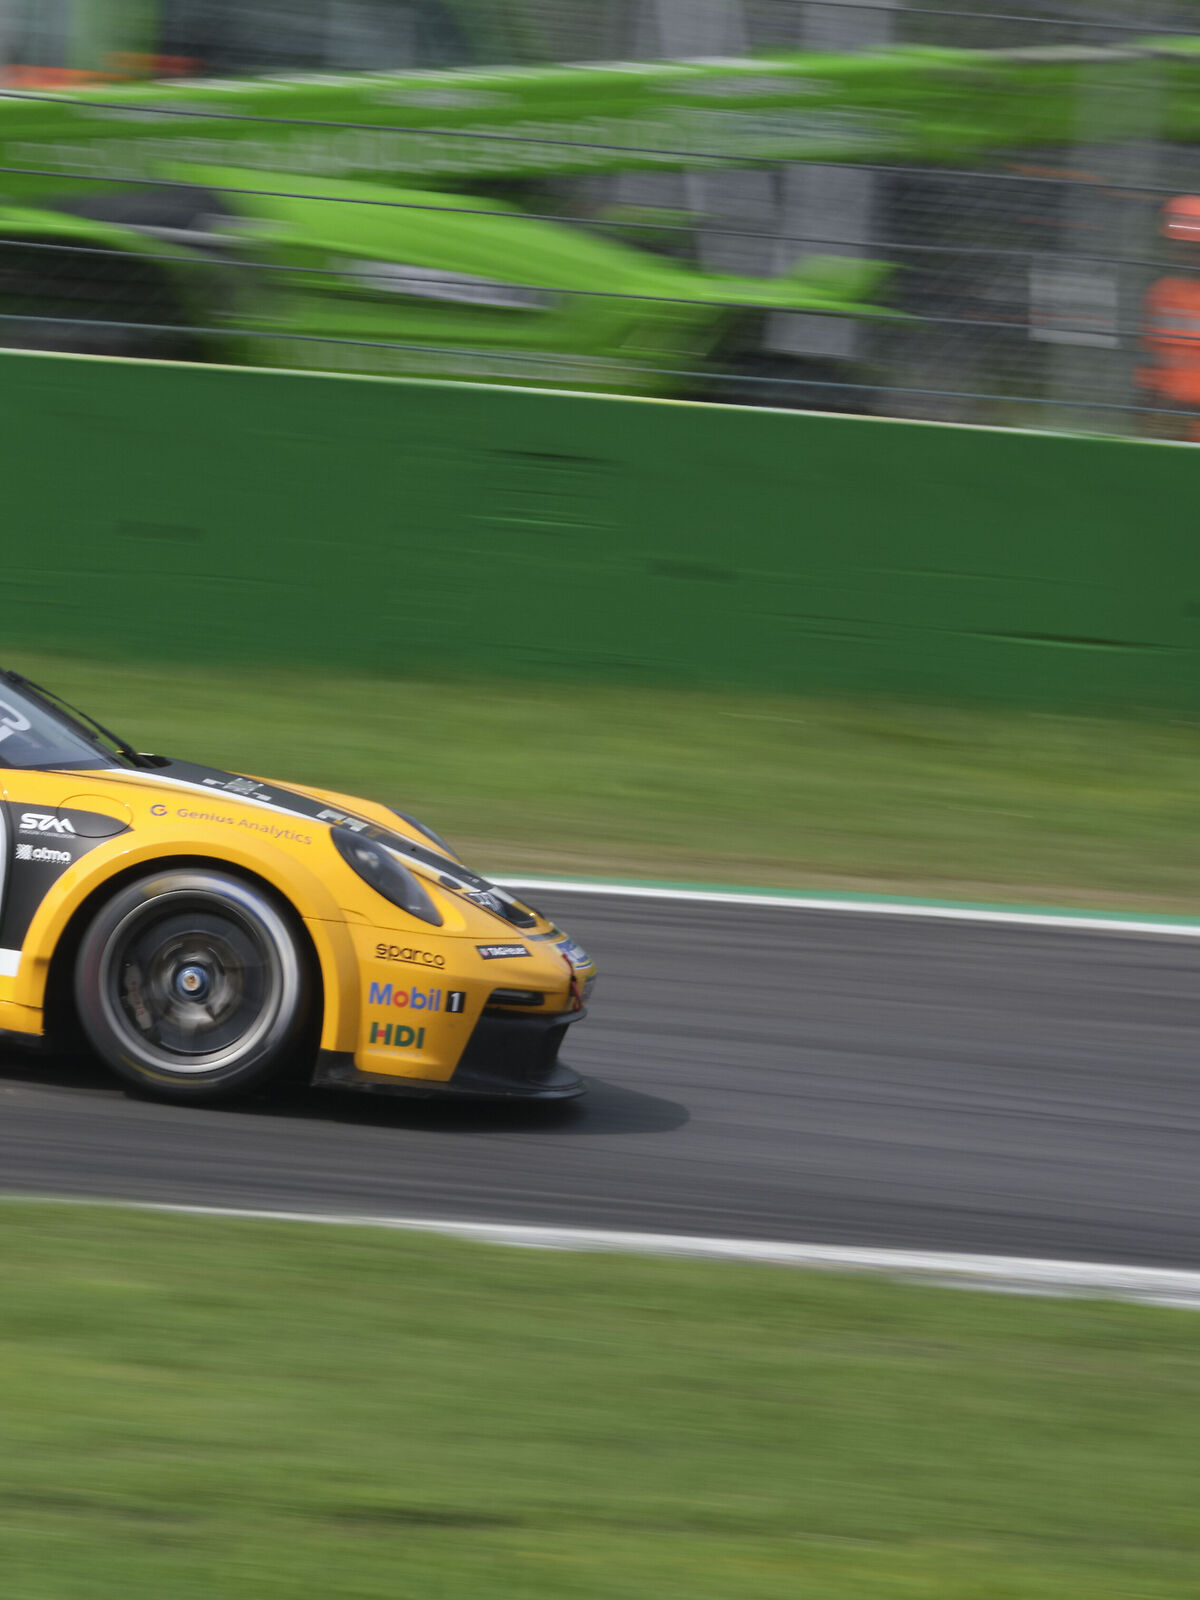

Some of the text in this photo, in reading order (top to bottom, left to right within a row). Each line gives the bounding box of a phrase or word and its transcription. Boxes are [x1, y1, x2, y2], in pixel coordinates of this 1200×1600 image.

[176, 808, 234, 825] Genius
[237, 818, 312, 845] Analytics
[375, 943, 446, 967] sparco
[368, 981, 461, 1012] Mobil 1
[369, 1022, 425, 1049] HDI
